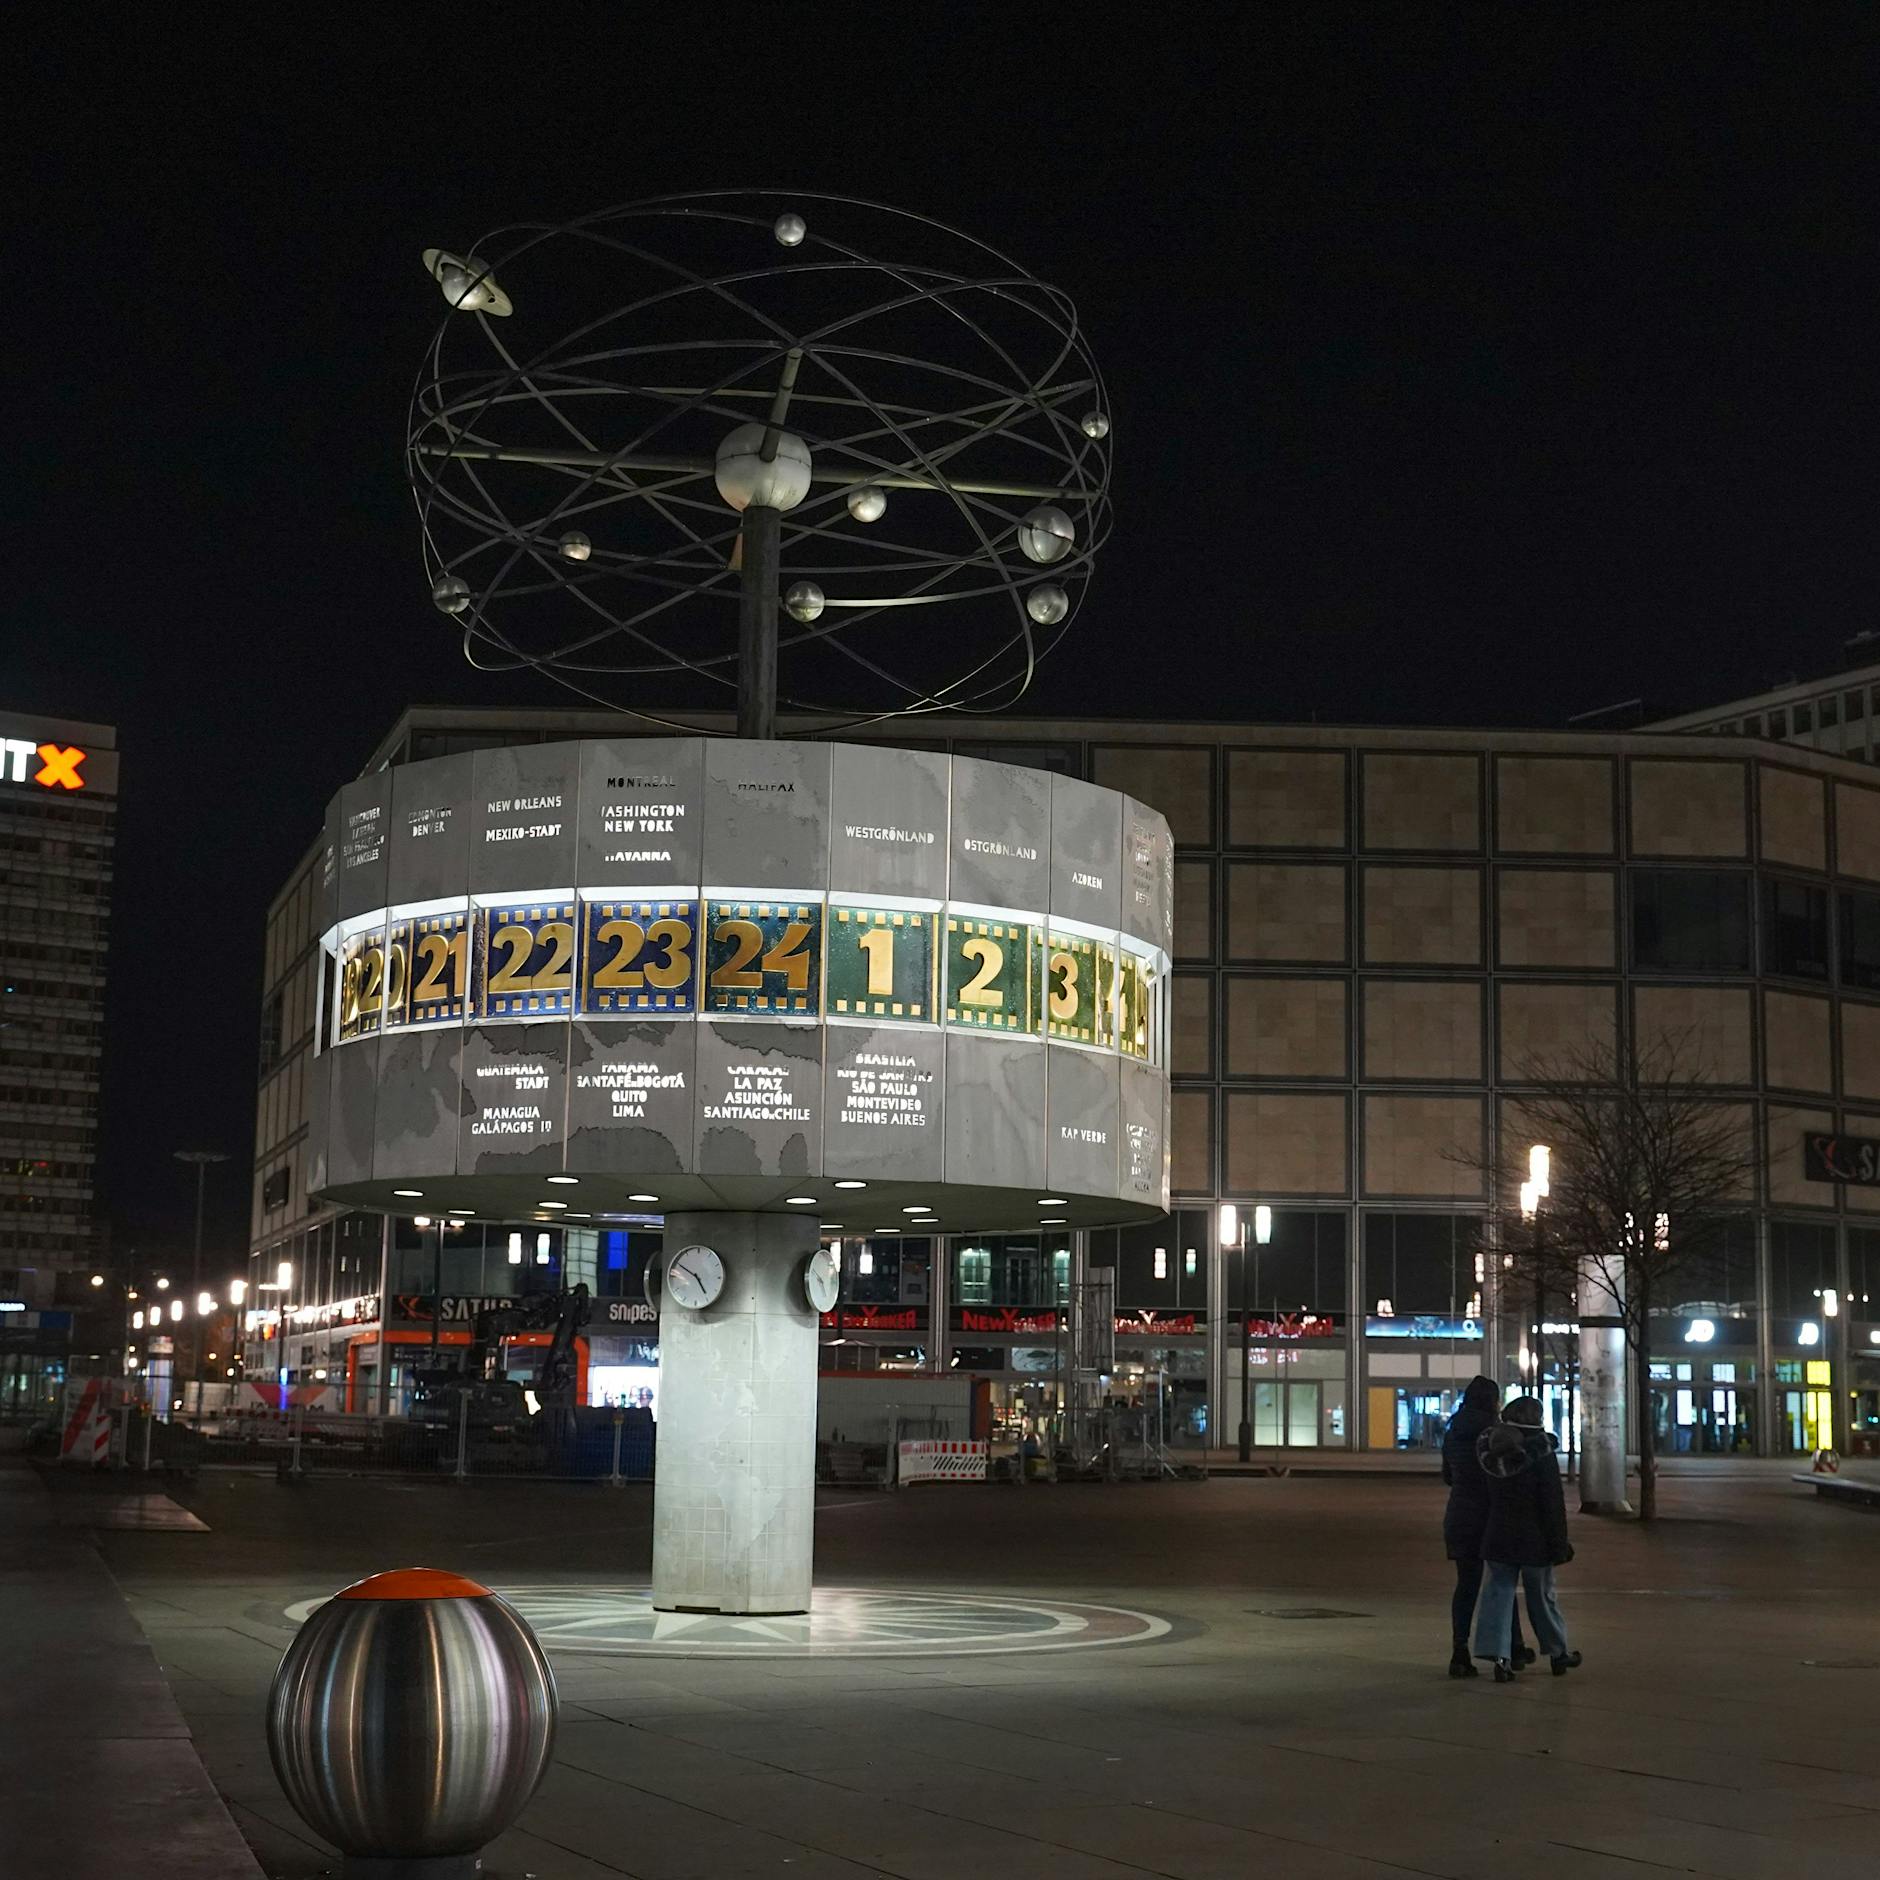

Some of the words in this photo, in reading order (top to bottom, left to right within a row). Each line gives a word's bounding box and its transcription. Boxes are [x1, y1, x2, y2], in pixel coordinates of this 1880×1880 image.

[606, 775, 677, 789] MONTREAL
[487, 800, 512, 814] NEW
[513, 795, 562, 811] ORLEANS
[412, 820, 446, 838] DENVER
[485, 823, 562, 843] MEXIKO-STADT
[604, 819, 635, 833] NEW
[638, 819, 674, 833] YORK
[844, 825, 935, 845] WESTGRÖNLAND
[1071, 871, 1103, 890] AZOREN
[488, 922, 573, 994] 22
[593, 919, 692, 989] 23
[710, 919, 813, 991] 24
[858, 928, 894, 996] 1
[413, 931, 467, 1003] 21
[958, 937, 1005, 1007] 2
[360, 947, 405, 1015] 20
[1049, 951, 1079, 1019] 3
[476, 1064, 545, 1078] GUATEMALA
[601, 1061, 659, 1073] PANAMA
[515, 1075, 550, 1090] STADT
[734, 1077, 752, 1090] LA
[756, 1077, 783, 1090] PAZ
[851, 1079, 876, 1094] SÃO
[880, 1081, 919, 1096] PAULO
[611, 1090, 648, 1103] QUITO
[723, 1091, 793, 1106] ASUNCIÓN
[846, 1095, 923, 1112] MONTEVIDEO
[483, 1106, 541, 1120] MANAGUA
[612, 1104, 645, 1117] LIMA
[840, 1110, 888, 1125] BUENOS
[890, 1112, 927, 1127] AIRES
[471, 1119, 534, 1135] GALÁPAGOS
[1061, 1126, 1079, 1141] KAP
[1080, 1129, 1107, 1145] VERDE
